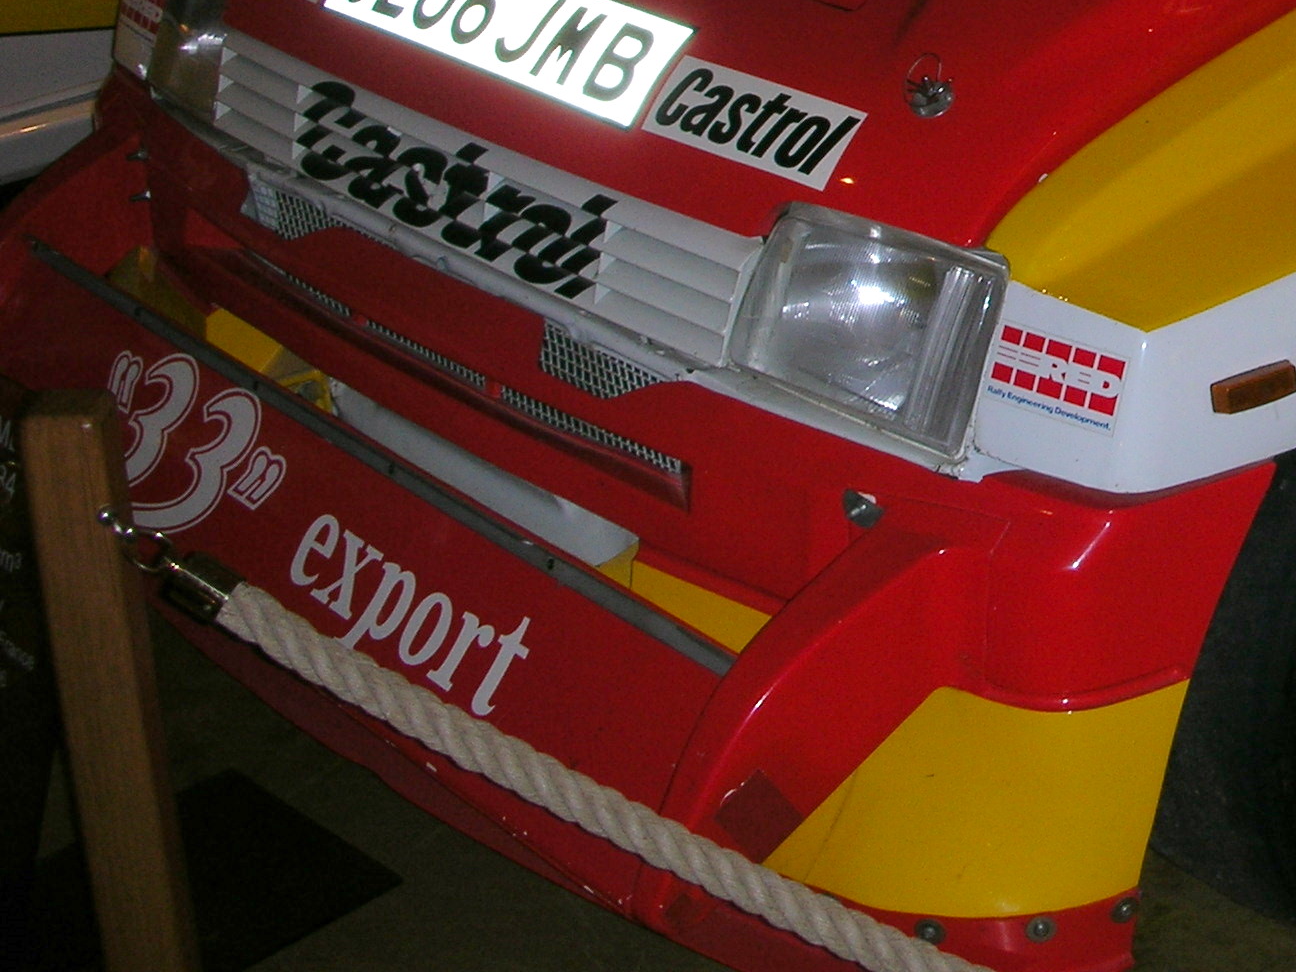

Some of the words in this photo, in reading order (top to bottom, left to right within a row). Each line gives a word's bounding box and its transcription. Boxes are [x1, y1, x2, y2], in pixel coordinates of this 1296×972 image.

[296, 79, 619, 300] Castrol
[653, 67, 861, 177] Castrol
[1006, 392, 1054, 415] Engineering
[288, 512, 532, 718] export
